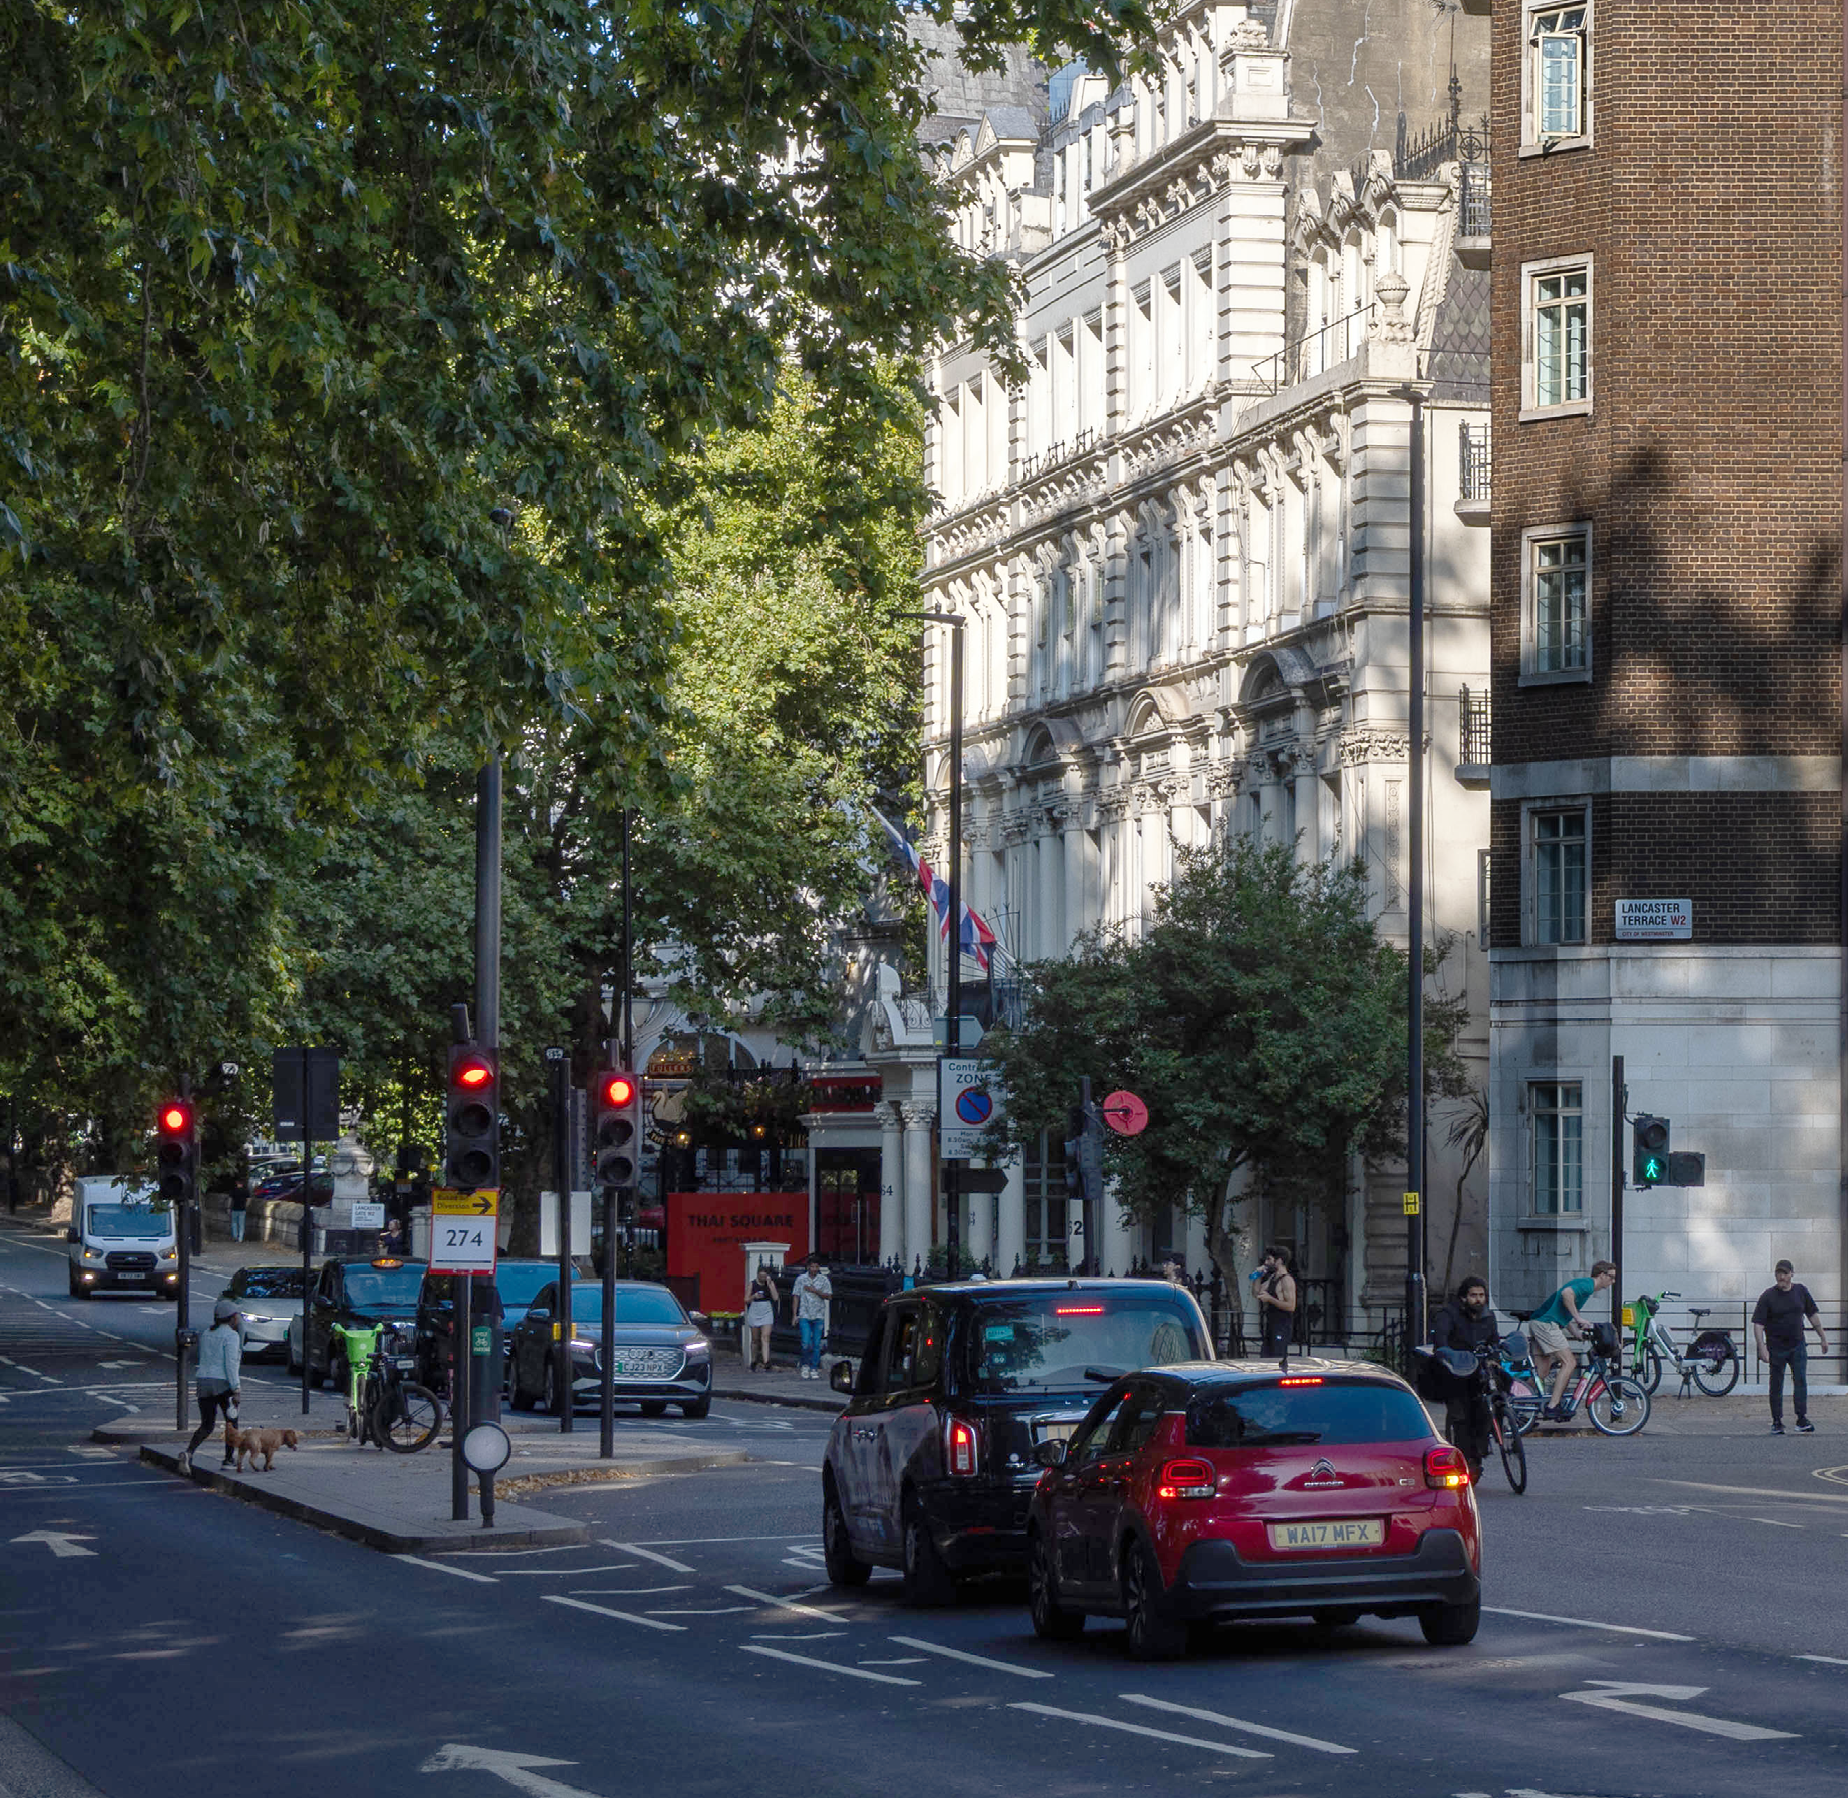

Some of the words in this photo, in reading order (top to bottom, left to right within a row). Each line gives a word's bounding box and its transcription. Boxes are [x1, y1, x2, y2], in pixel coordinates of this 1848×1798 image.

[1622, 903, 1680, 913] LANCASTER
[1622, 915, 1667, 925] TERRACE
[1670, 915, 1686, 925] W2
[688, 1215, 725, 1227] THAI
[730, 1215, 794, 1228] SQUARE
[446, 1229, 483, 1246] 274
[624, 1362, 645, 1371] CJ23
[647, 1362, 663, 1371] NPX
[1286, 1526, 1327, 1544] WA17
[1332, 1524, 1369, 1542] MFX
